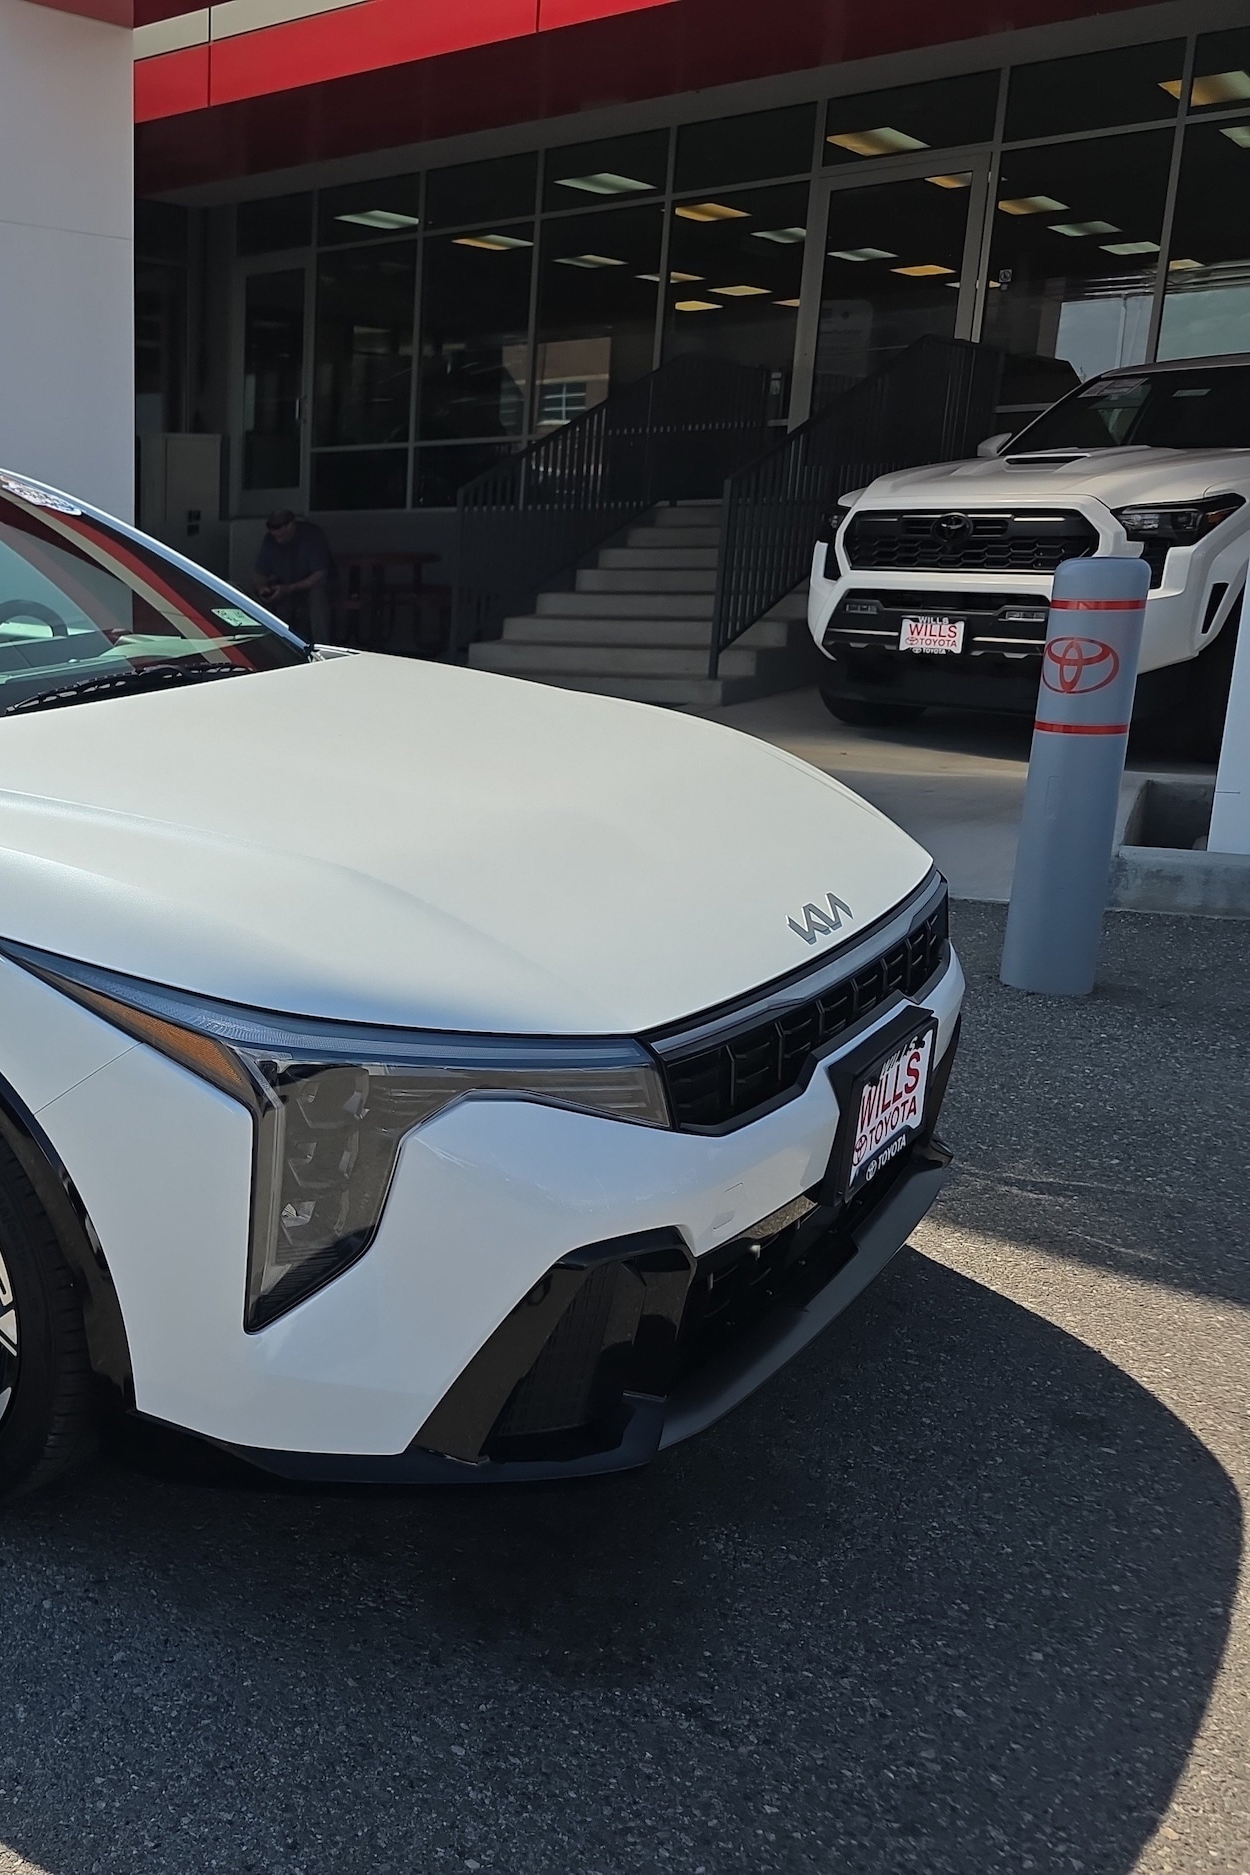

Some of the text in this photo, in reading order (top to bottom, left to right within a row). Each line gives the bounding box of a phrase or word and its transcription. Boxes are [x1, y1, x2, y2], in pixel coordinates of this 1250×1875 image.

[909, 624, 957, 638] WILLS
[918, 616, 949, 625] WILLS
[919, 638, 957, 647] TOYOTA
[785, 892, 854, 945] KIA
[860, 1051, 920, 1133] WILLS
[867, 1095, 917, 1150] TOYOTA
[877, 1133, 906, 1170] TOYOTA
